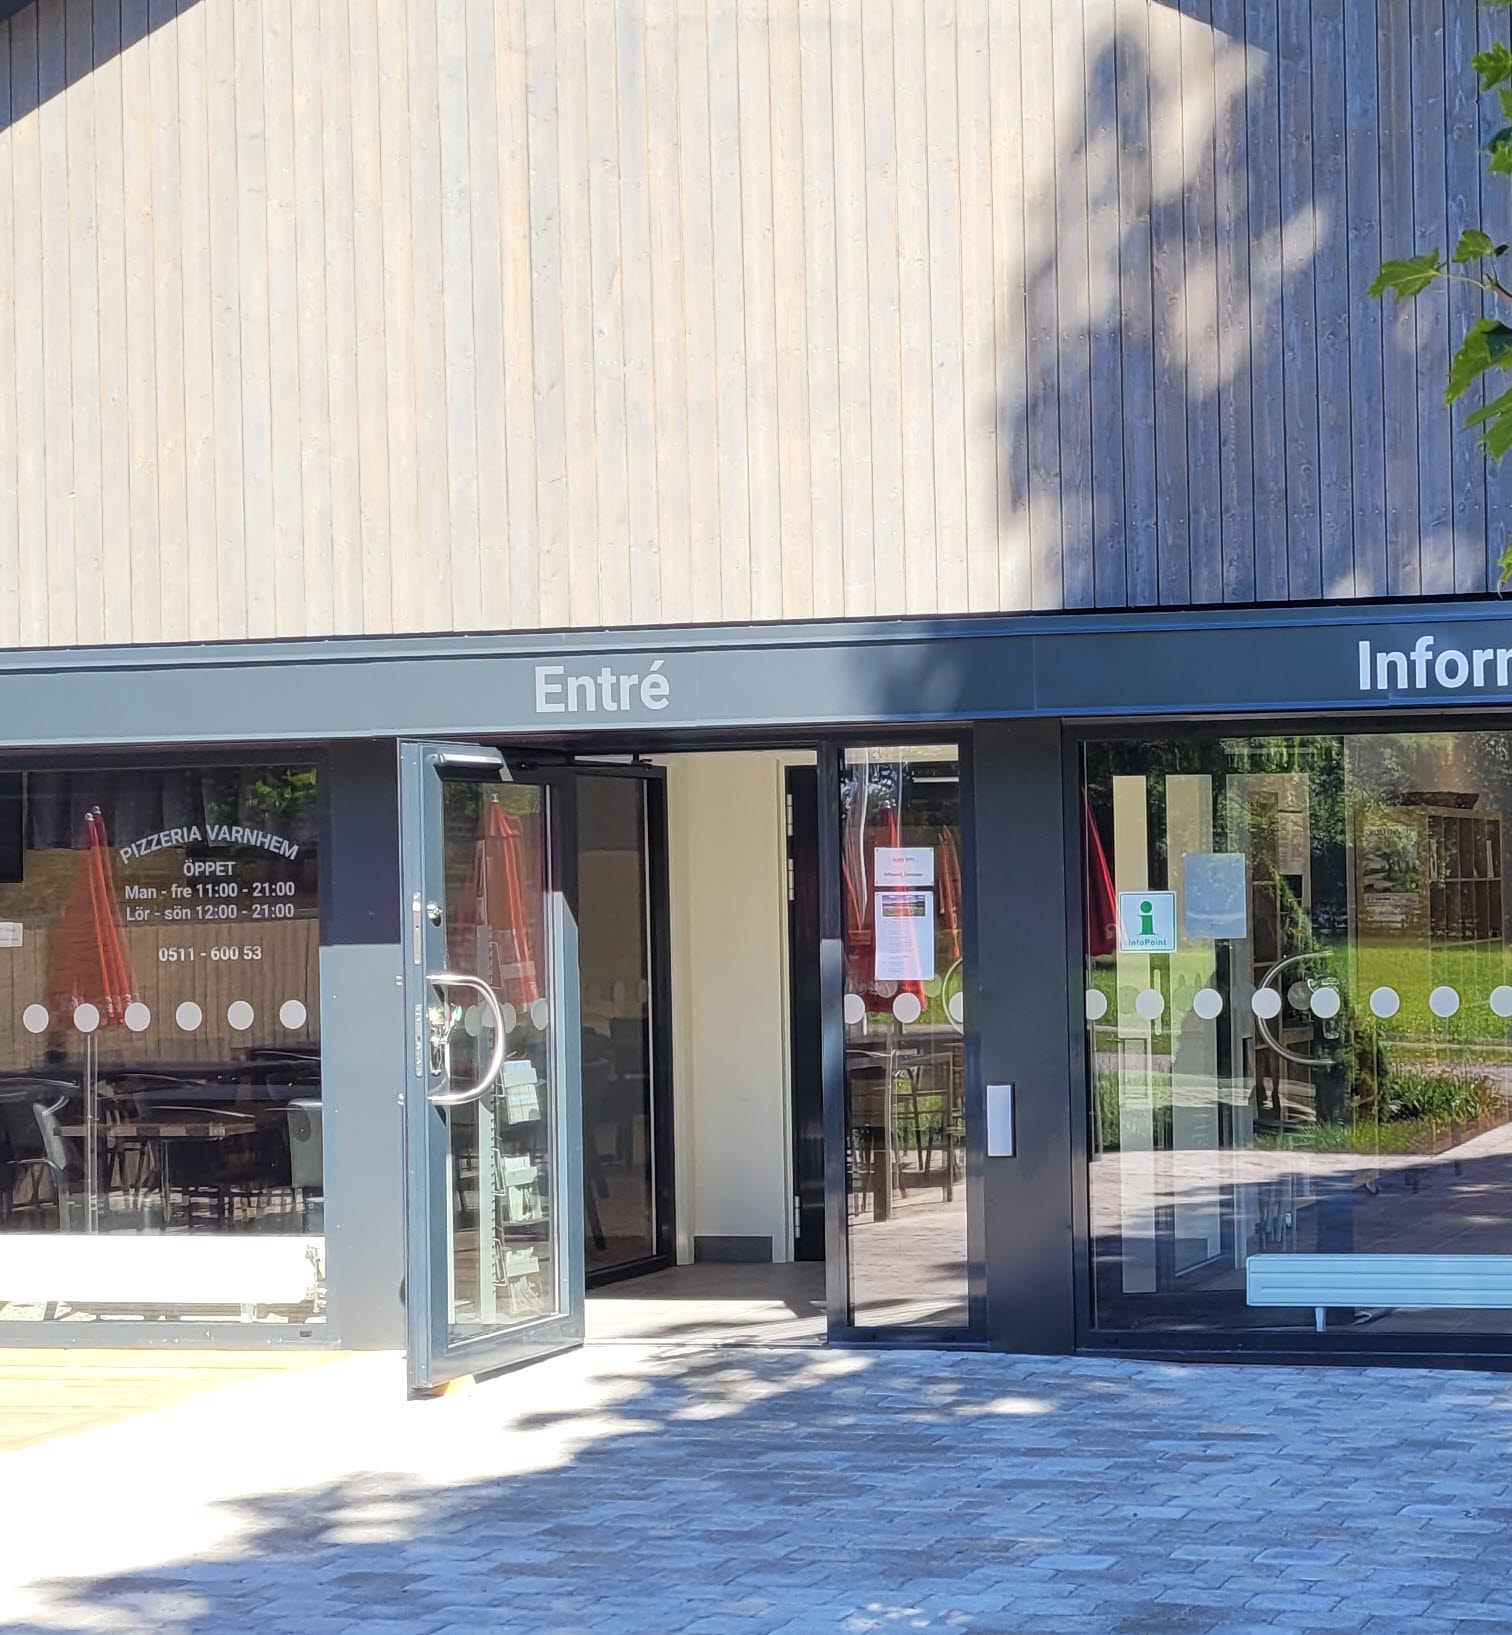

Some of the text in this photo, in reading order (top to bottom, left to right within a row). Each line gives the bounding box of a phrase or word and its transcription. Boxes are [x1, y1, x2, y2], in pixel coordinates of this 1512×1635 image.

[534, 659, 671, 713] Entré
[118, 824, 300, 864] PIZZERIA VARNHEM
[183, 859, 237, 877] ÖPPET
[125, 885, 157, 900] Man
[171, 883, 192, 899] fre
[196, 882, 238, 898] 11:00
[252, 881, 295, 897] 21:00
[126, 906, 150, 922] Lör
[164, 905, 192, 920] sön
[196, 904, 238, 919] 12:00
[252, 903, 295, 918] 21:00
[158, 946, 195, 962] 0511
[210, 946, 239, 961] 600
[243, 945, 262, 961] 53
